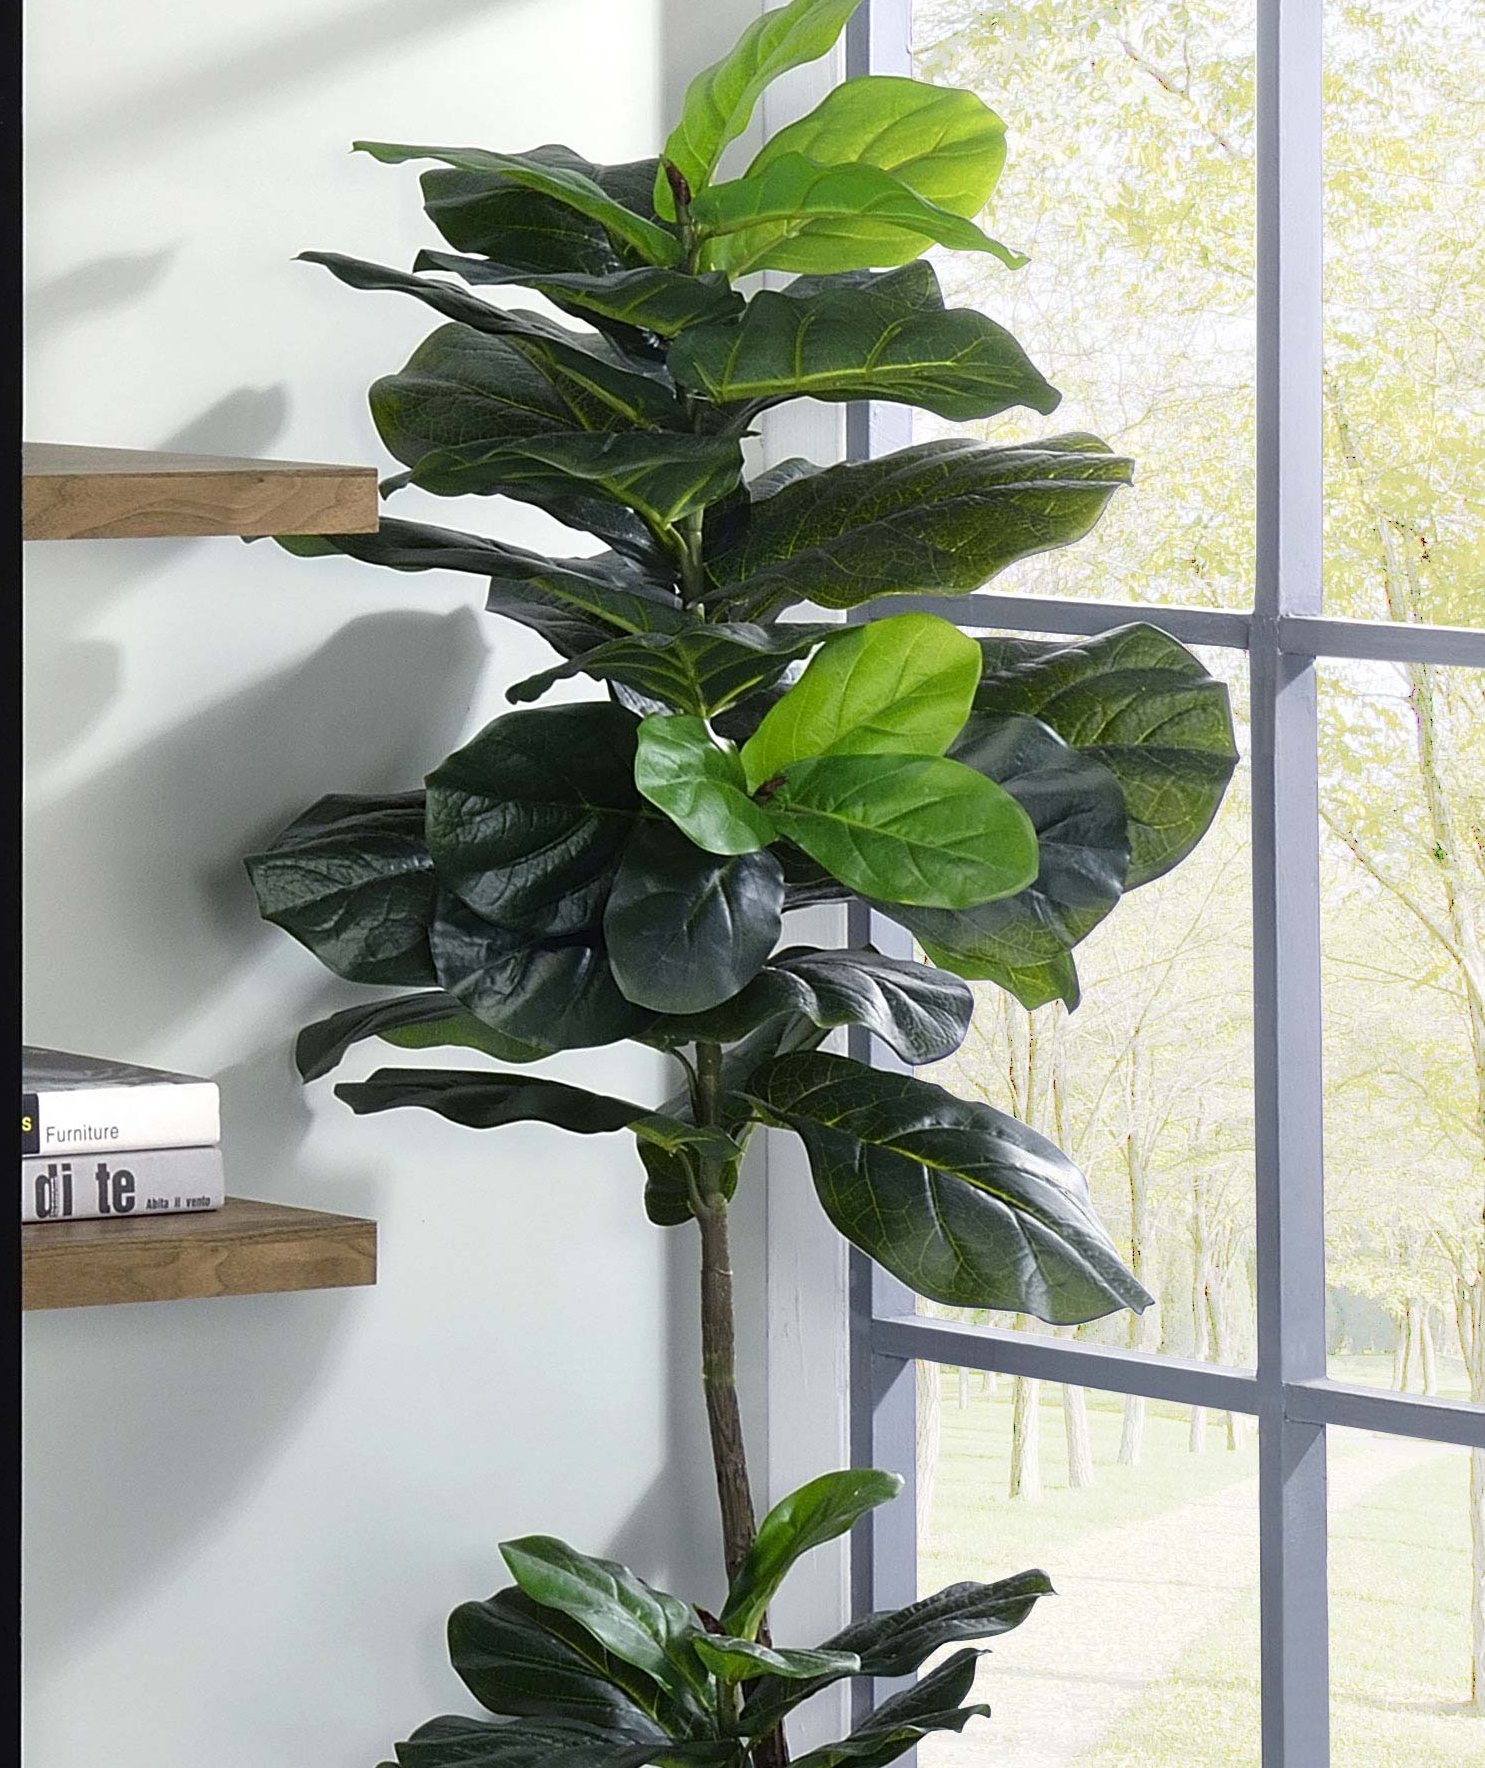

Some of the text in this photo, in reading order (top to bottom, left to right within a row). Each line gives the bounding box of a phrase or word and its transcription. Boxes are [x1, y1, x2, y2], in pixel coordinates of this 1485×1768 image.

[46, 1124, 119, 1143] Furniture
[35, 1163, 135, 1218] di te
[186, 1196, 210, 1208] vento
